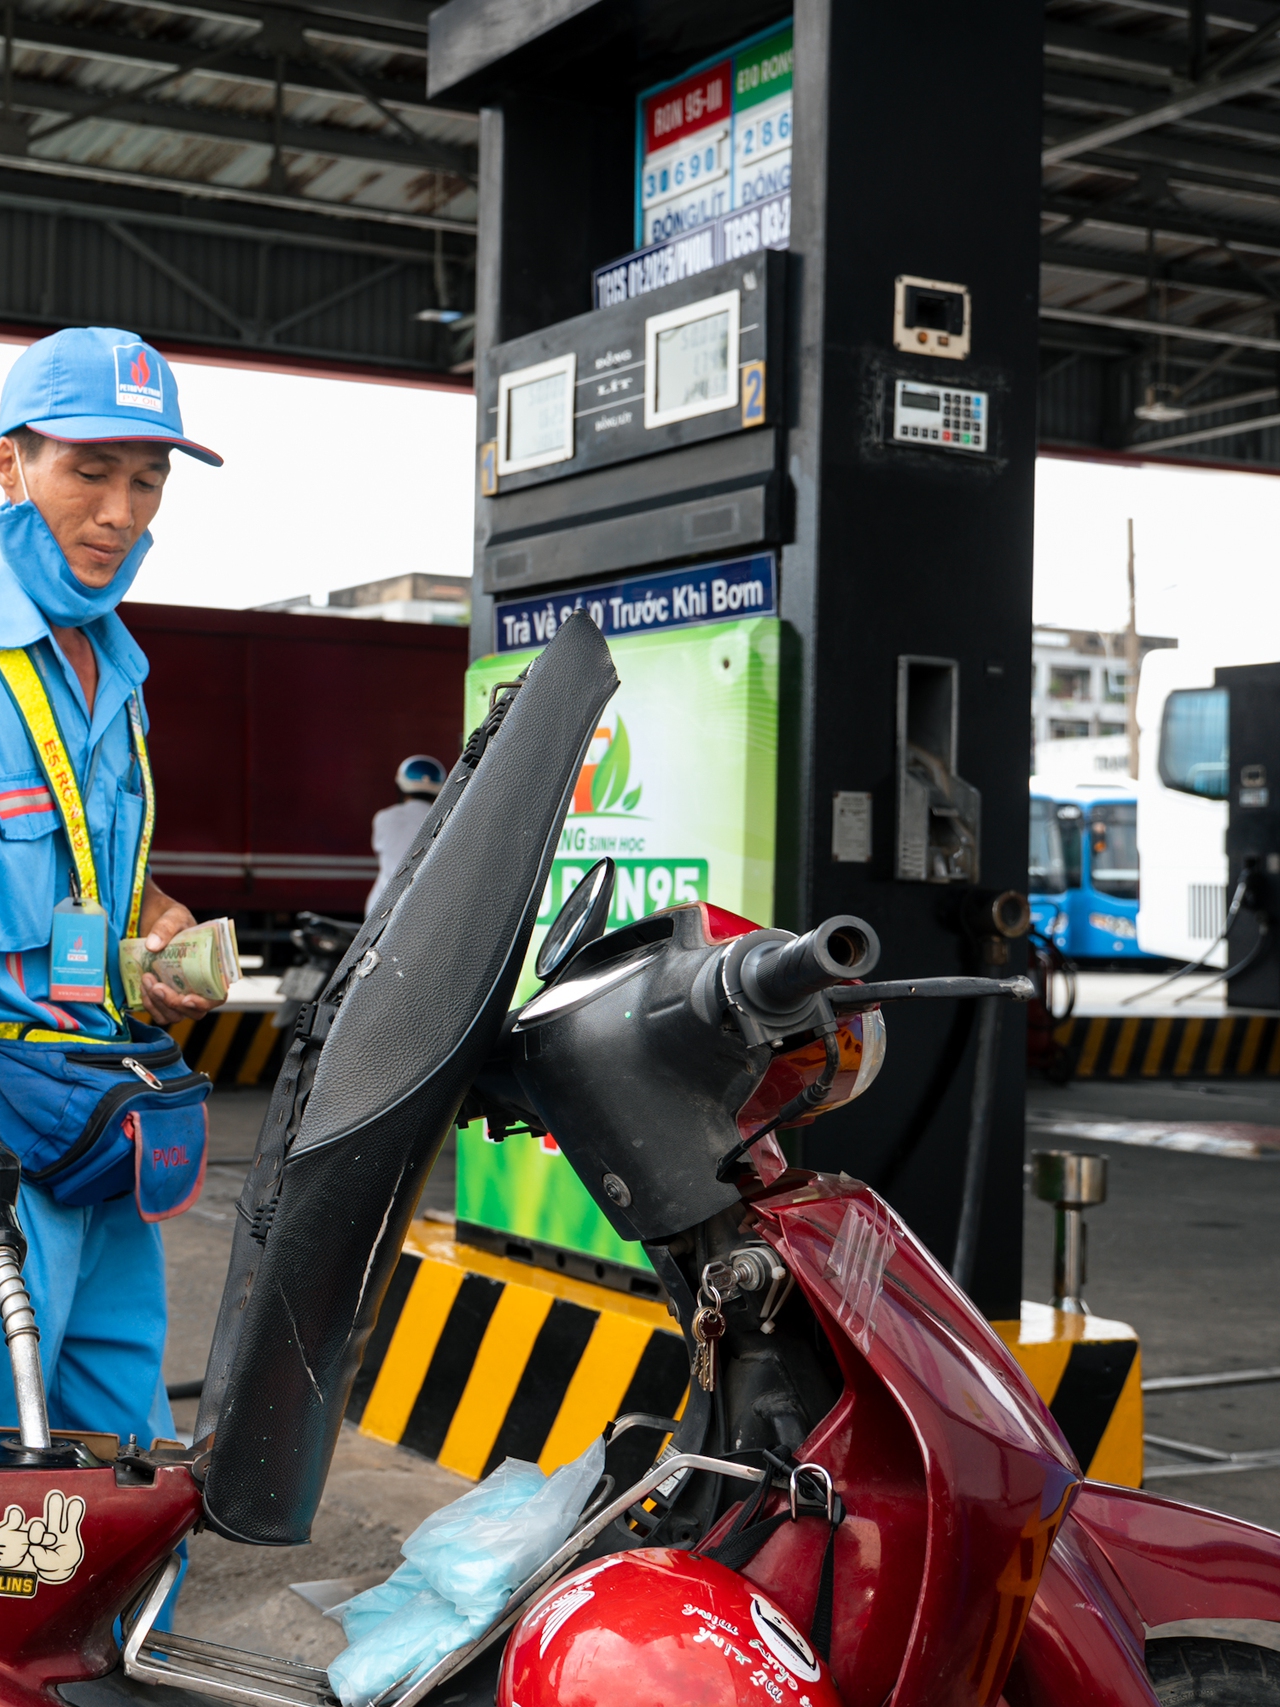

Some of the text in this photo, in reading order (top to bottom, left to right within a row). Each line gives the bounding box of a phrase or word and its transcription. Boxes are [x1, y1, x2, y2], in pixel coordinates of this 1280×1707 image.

[737, 63, 760, 95] E10
[654, 98, 683, 138] RON
[745, 369, 763, 418] 2
[482, 449, 495, 491] 1
[503, 612, 531, 646] Trả
[533, 602, 557, 643] Về
[610, 591, 669, 630] Trước
[673, 583, 708, 619] Khi
[711, 578, 764, 613] Bơm
[589, 836, 616, 852] SINH
[620, 838, 646, 856] HỌC
[152, 1145, 190, 1171] PVOIL
